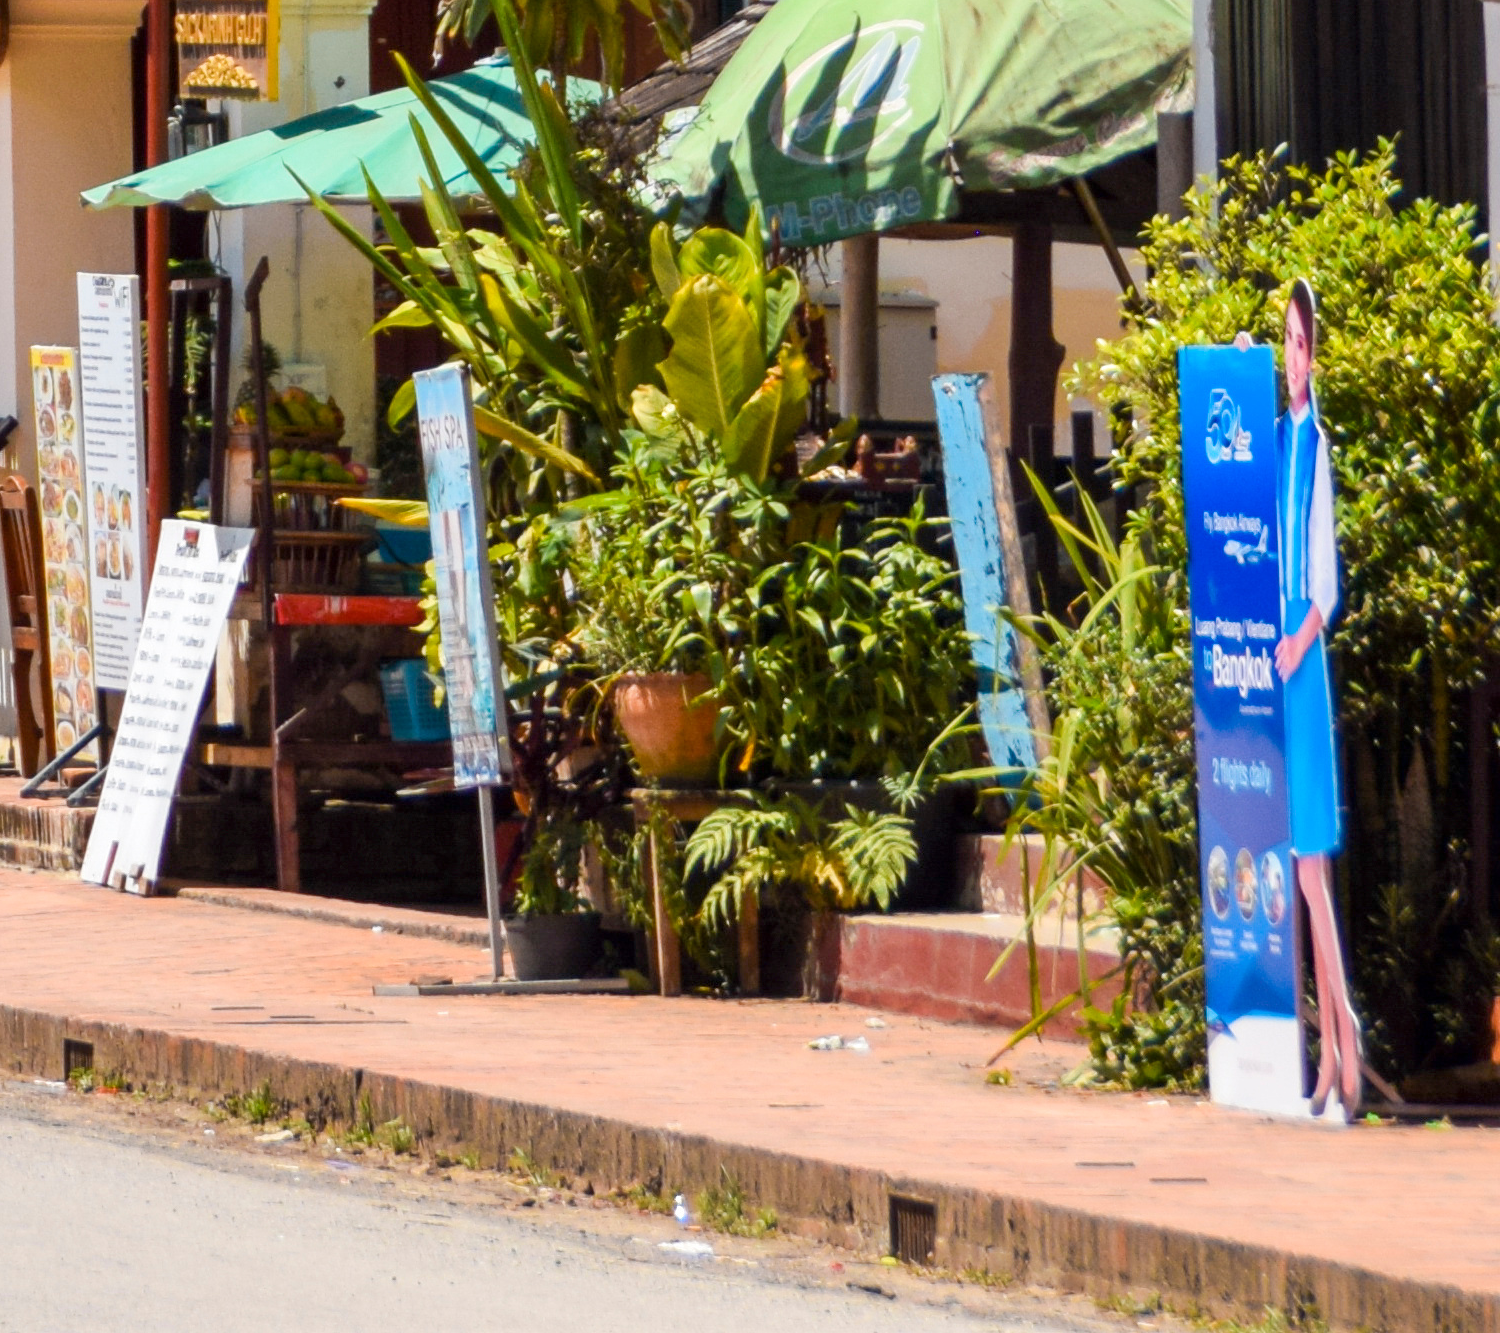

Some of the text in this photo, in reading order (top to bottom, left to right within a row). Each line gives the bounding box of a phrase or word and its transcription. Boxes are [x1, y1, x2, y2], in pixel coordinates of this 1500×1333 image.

[768, 183, 922, 241] M-Phone
[420, 413, 464, 453] FISH SPA
[1212, 643, 1274, 699] Bangkok
[1212, 757, 1220, 785] 2
